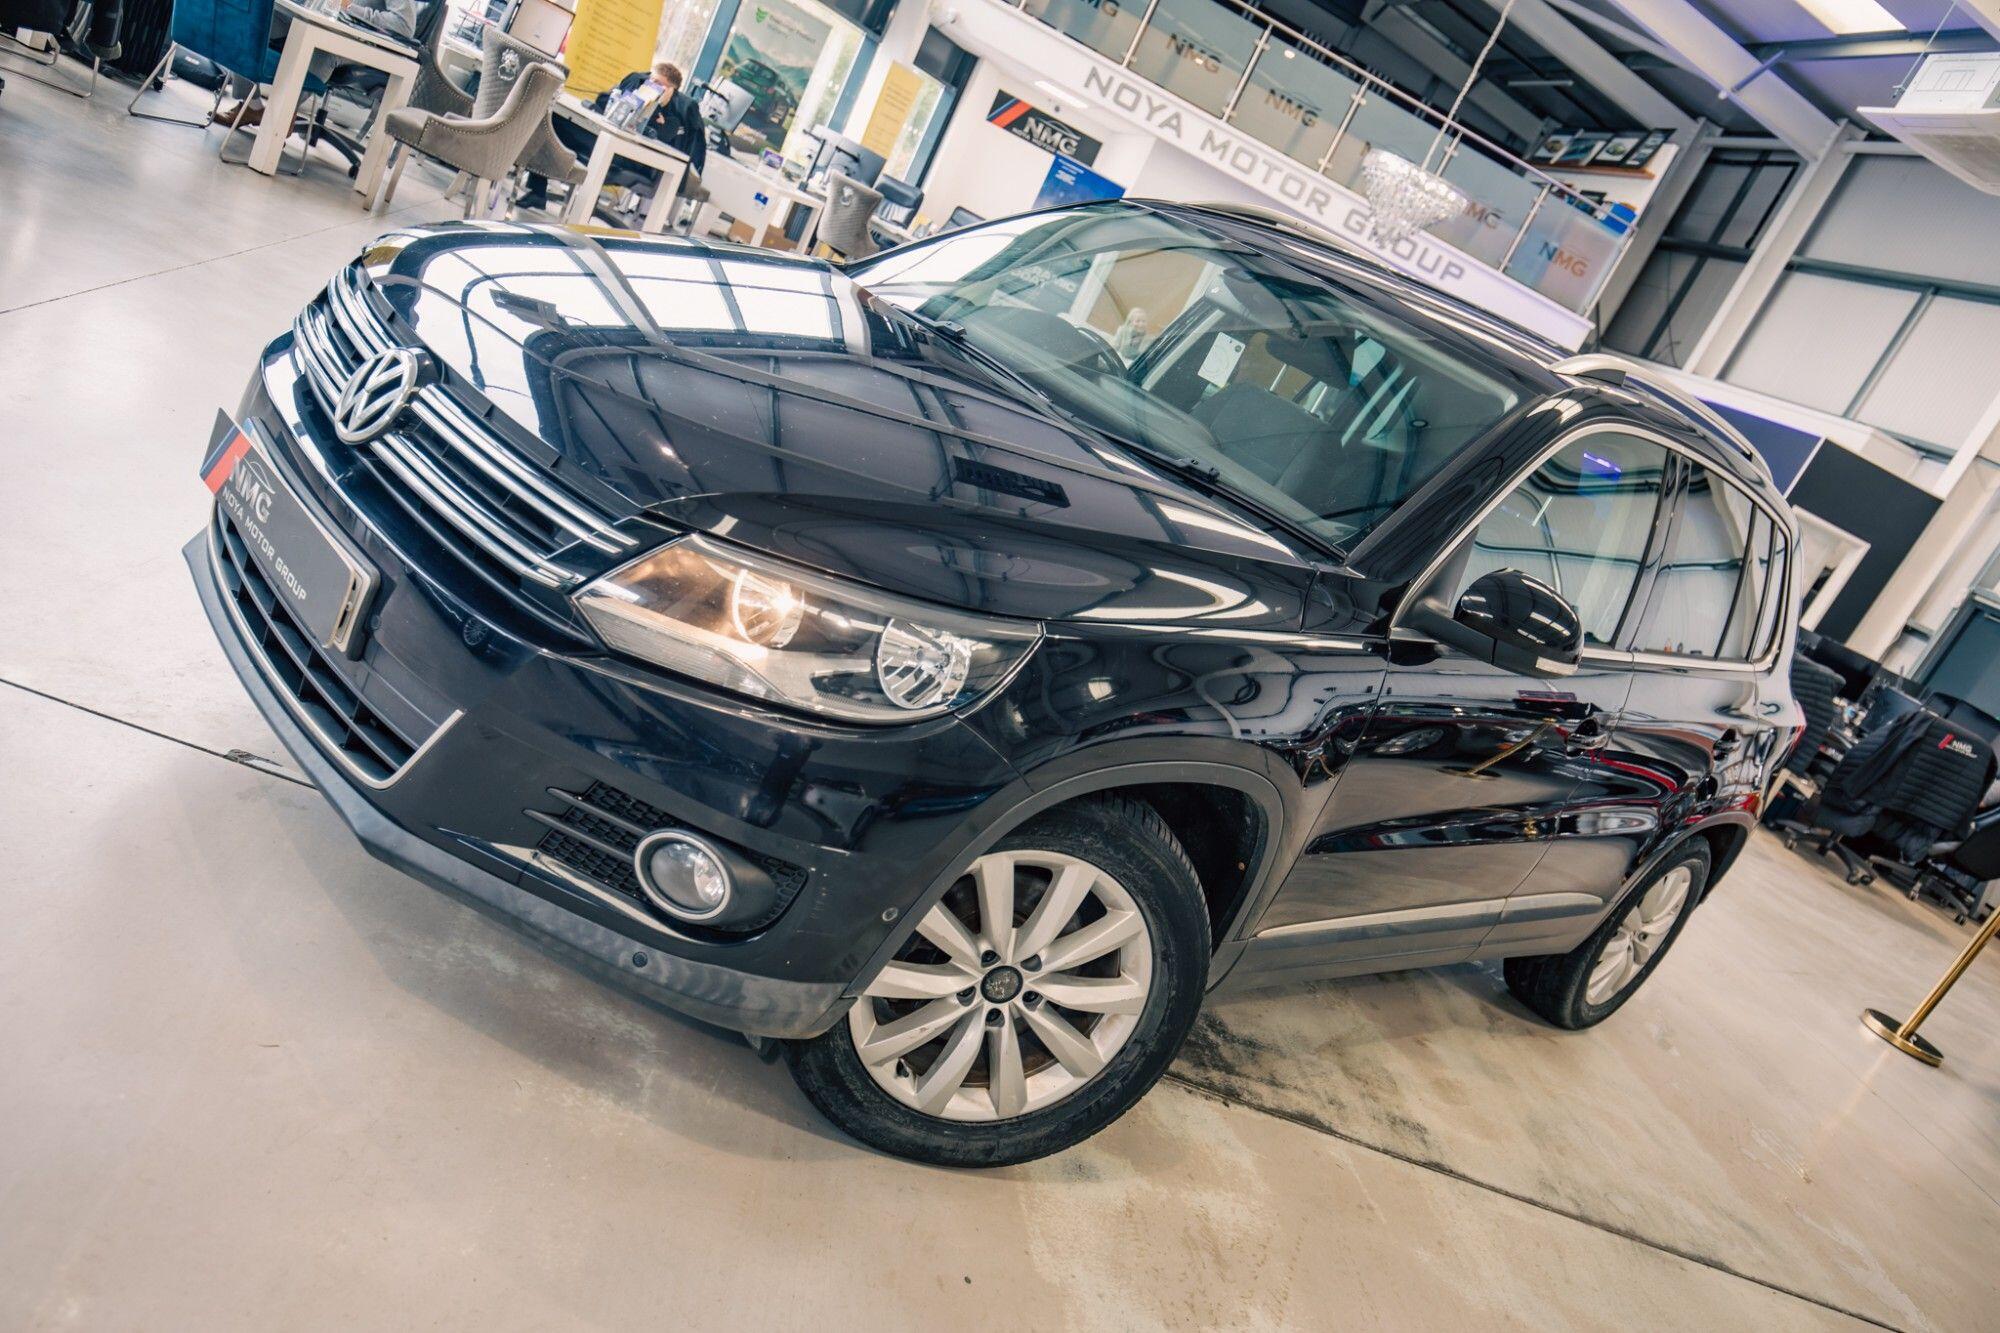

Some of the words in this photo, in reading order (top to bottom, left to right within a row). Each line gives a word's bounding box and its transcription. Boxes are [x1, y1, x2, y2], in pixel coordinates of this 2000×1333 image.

[1166, 32, 1222, 74] NMG
[1264, 88, 1320, 128] NMG
[1023, 116, 1079, 156] NMG
[1083, 66, 1182, 139] NOYA
[1199, 128, 1332, 216] MOTOR
[1463, 201, 1502, 230] MG
[1538, 240, 1588, 278] NMG
[228, 454, 273, 524] NMG
[222, 486, 244, 521] NOYA
[244, 515, 276, 561] MOTOR
[274, 556, 308, 601] GROUP
